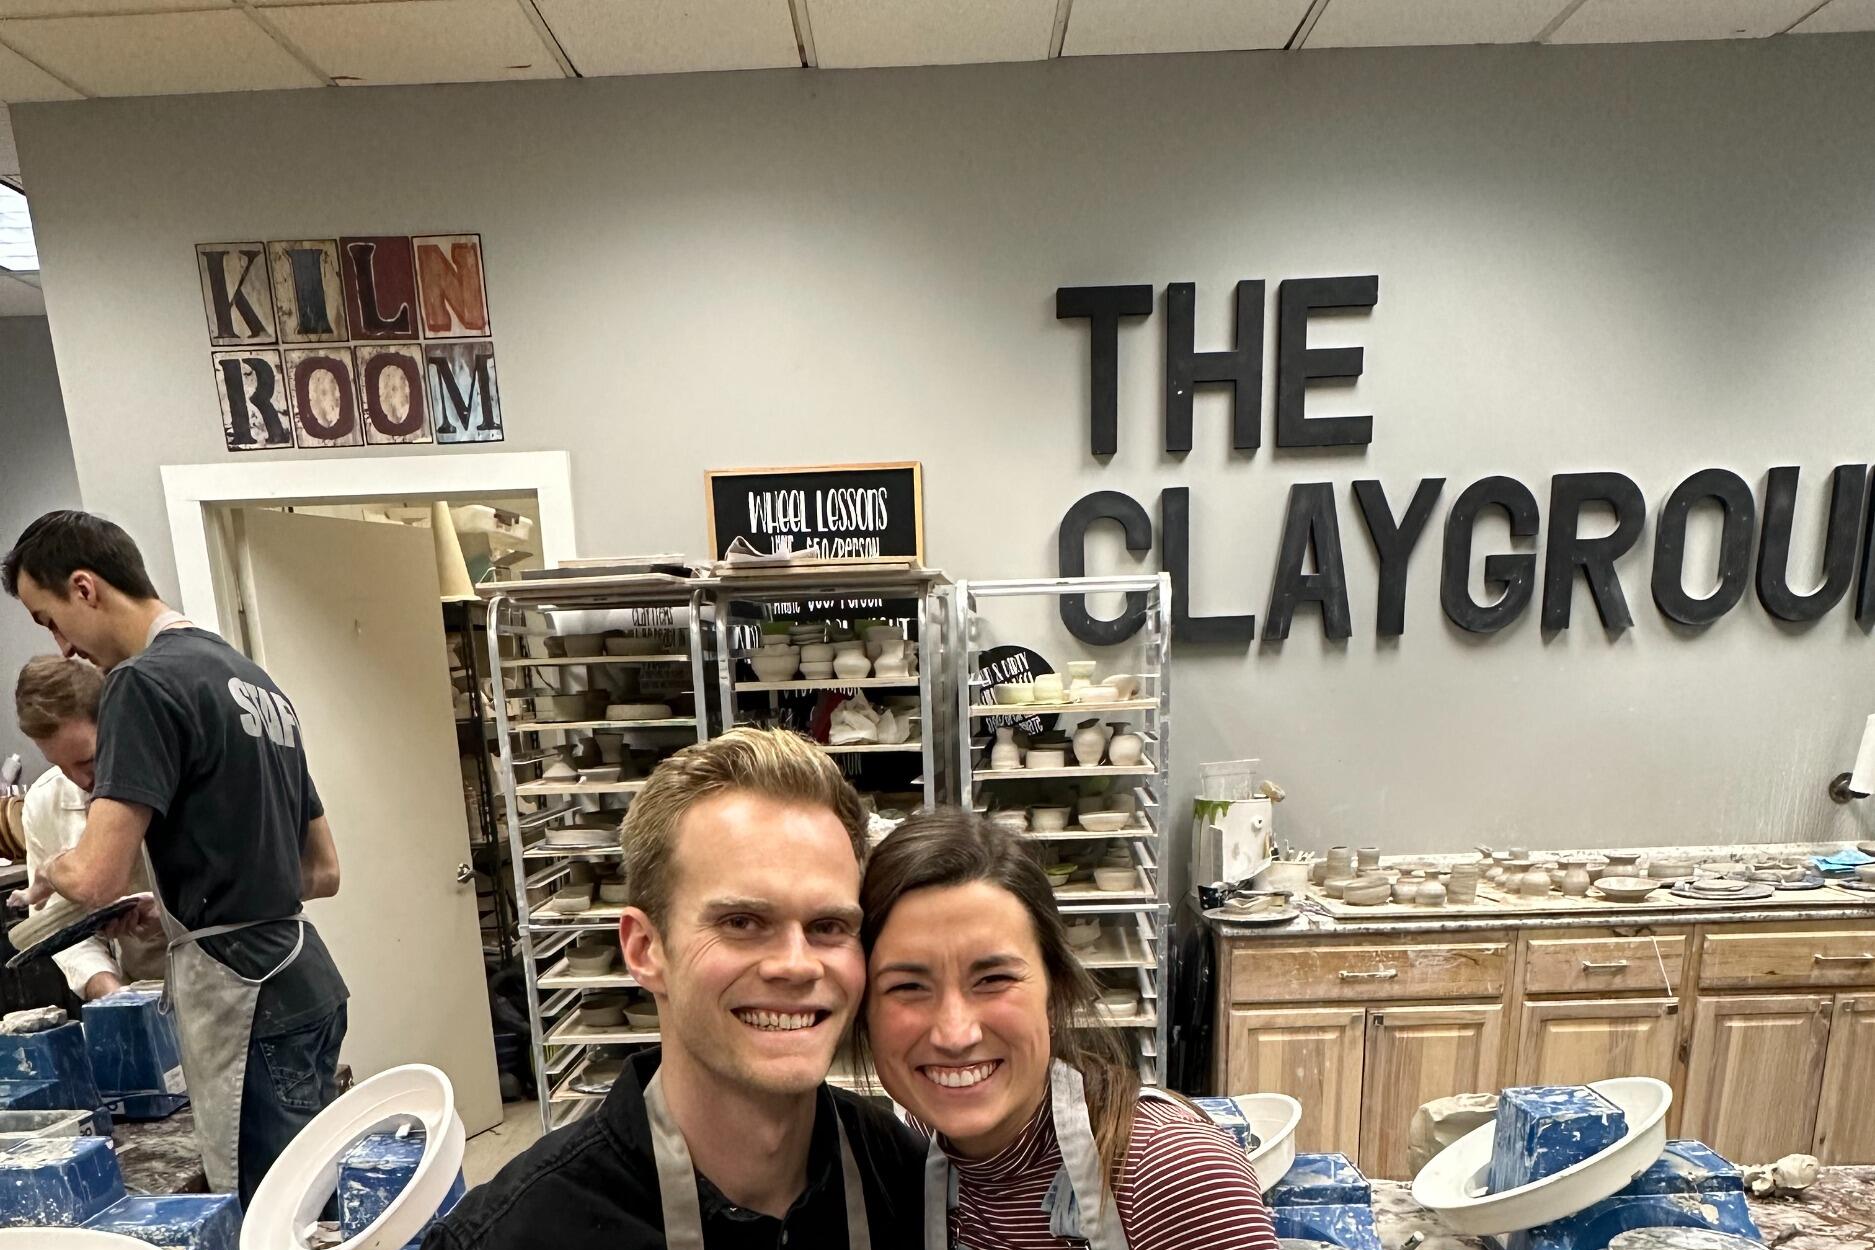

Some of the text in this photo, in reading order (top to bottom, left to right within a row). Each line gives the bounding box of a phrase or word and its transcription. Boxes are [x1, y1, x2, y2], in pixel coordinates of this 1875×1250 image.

[200, 242, 487, 339] KILN
[218, 352, 502, 446] ROOM
[1056, 275, 1379, 455] THE
[1059, 464, 1875, 645] CLAYGROU
